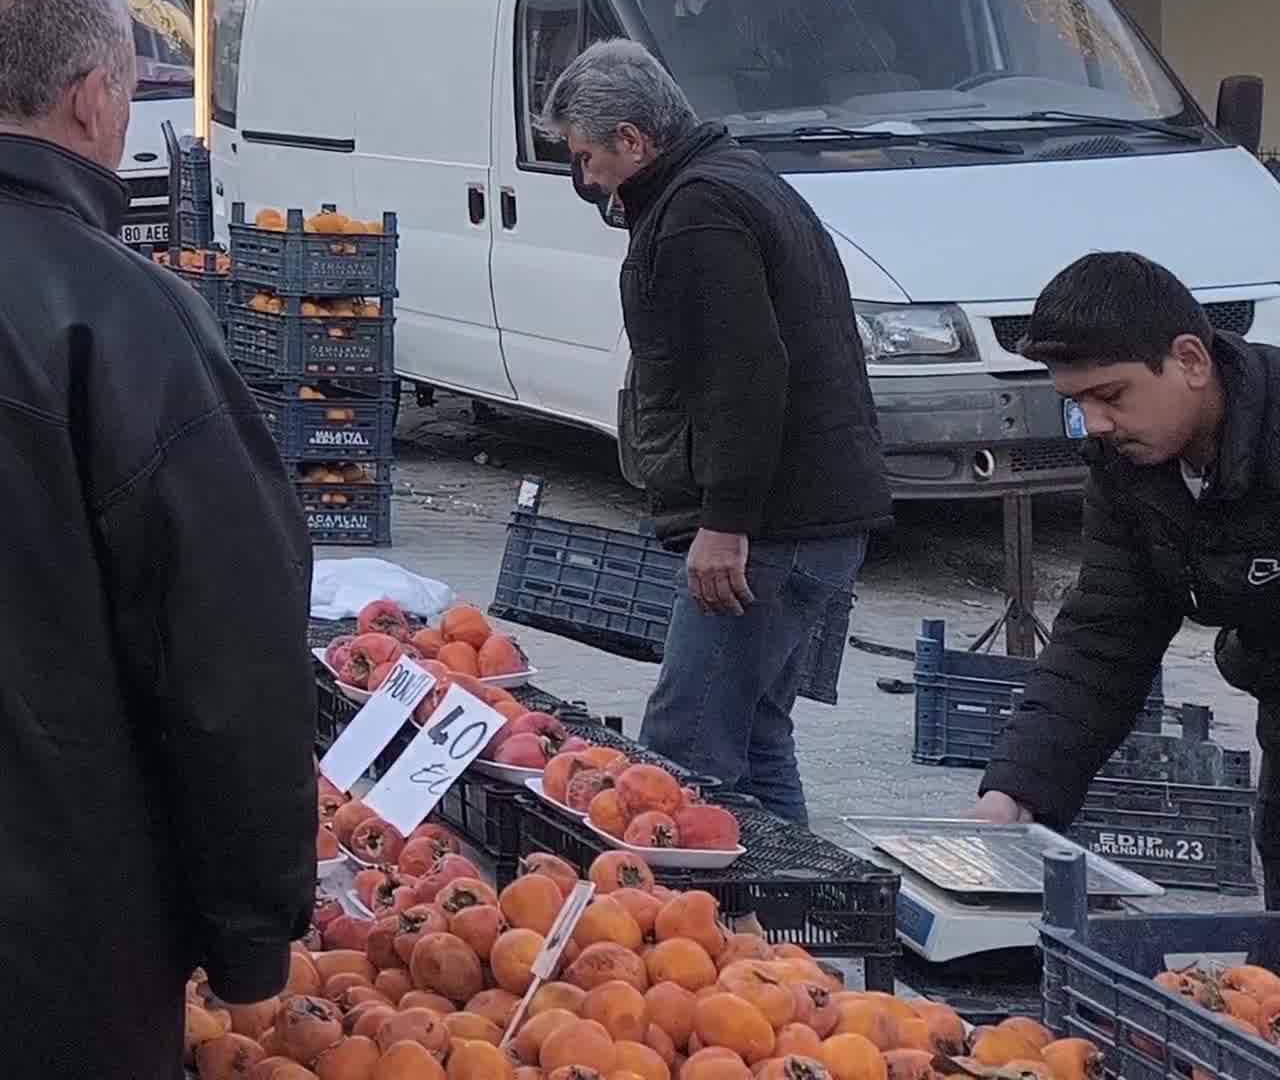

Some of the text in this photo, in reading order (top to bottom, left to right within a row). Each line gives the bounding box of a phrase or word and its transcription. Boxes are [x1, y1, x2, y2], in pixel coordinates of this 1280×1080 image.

[124, 226, 141, 241] 80
[427, 704, 488, 760] 40
[1176, 839, 1204, 860] 23
